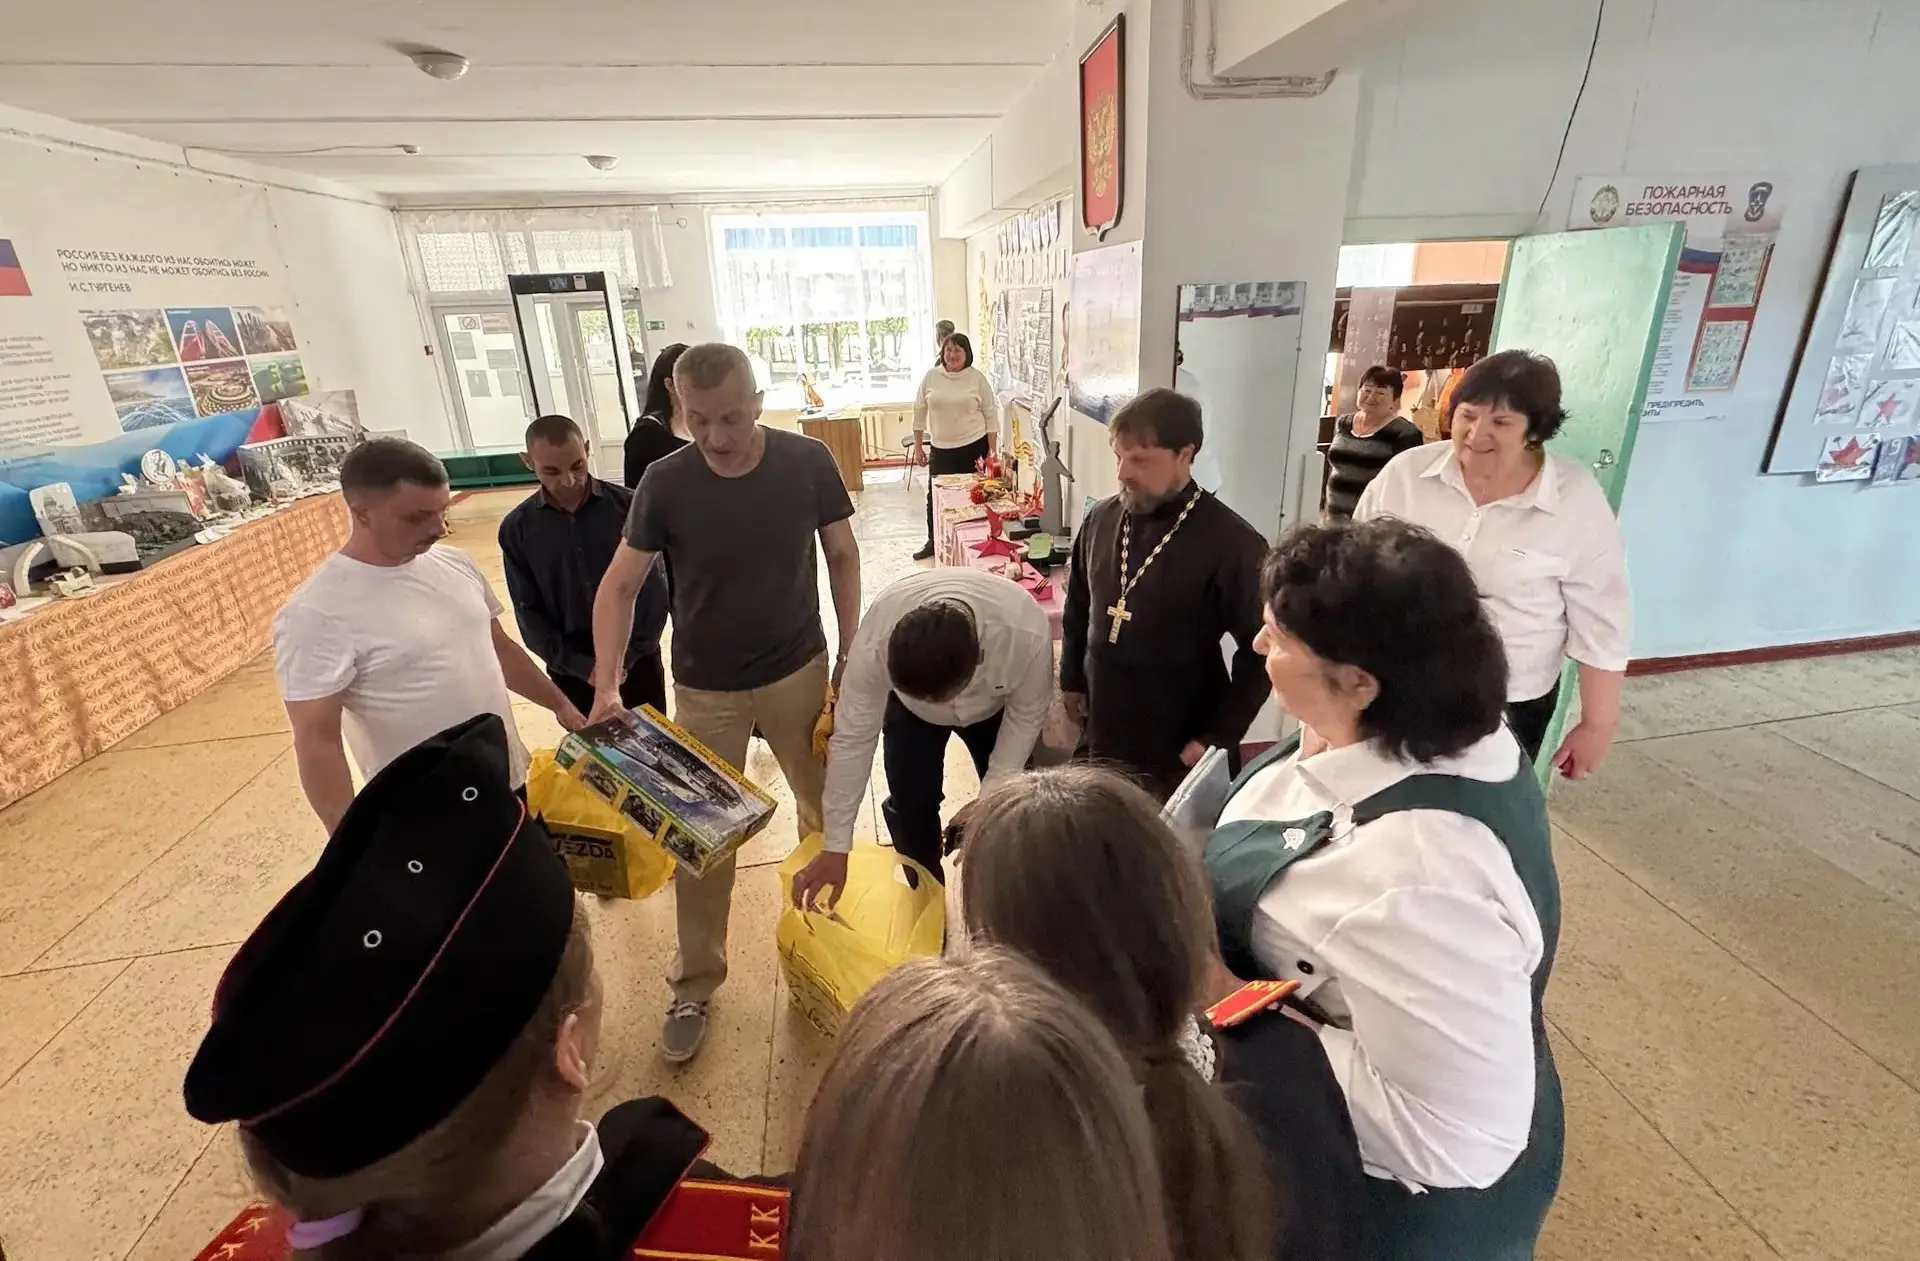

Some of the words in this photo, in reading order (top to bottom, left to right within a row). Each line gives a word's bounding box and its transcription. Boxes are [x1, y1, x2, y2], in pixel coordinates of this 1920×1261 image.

[1642, 185, 1727, 200] ПОЖАРНАЯ
[1625, 201, 1733, 216] БЕЗОПАСНОСТЬ
[56, 248, 99, 260] РОССИЯ
[99, 251, 118, 262] БЕЗ
[118, 252, 163, 264] КАЖДОГО
[163, 255, 176, 265] ИЗ
[176, 256, 193, 266] НАС
[61, 261, 78, 272] НО
[80, 263, 113, 273] НИКТО
[114, 264, 128, 273] ИЗ
[128, 264, 148, 274] НАС
[148, 265, 160, 275] НЕ
[160, 266, 190, 276] МОЖЕТ
